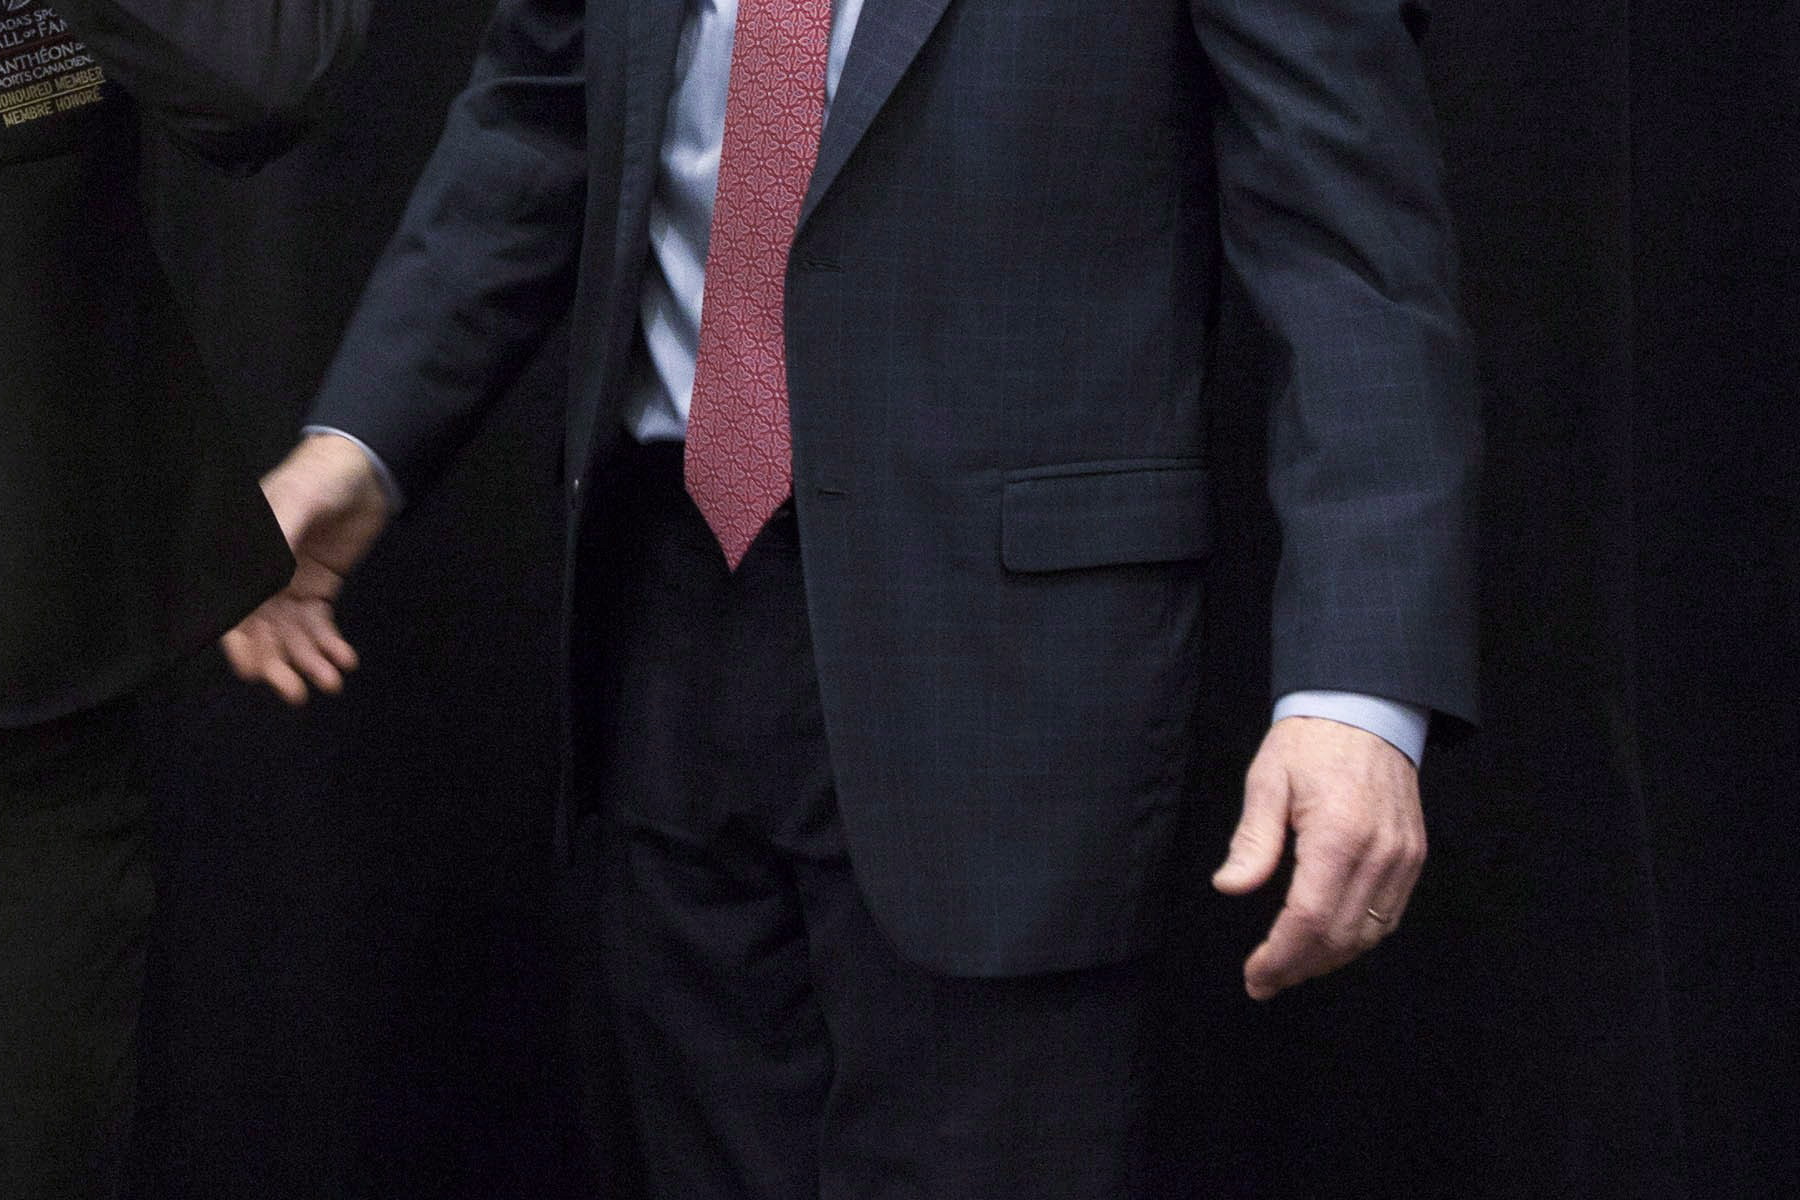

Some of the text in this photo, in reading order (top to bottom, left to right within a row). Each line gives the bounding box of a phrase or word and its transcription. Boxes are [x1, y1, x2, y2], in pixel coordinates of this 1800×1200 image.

[32, 55, 95, 79] CANADIEN
[55, 66, 104, 90] MEMBER
[2, 101, 54, 128] MEMBRE
